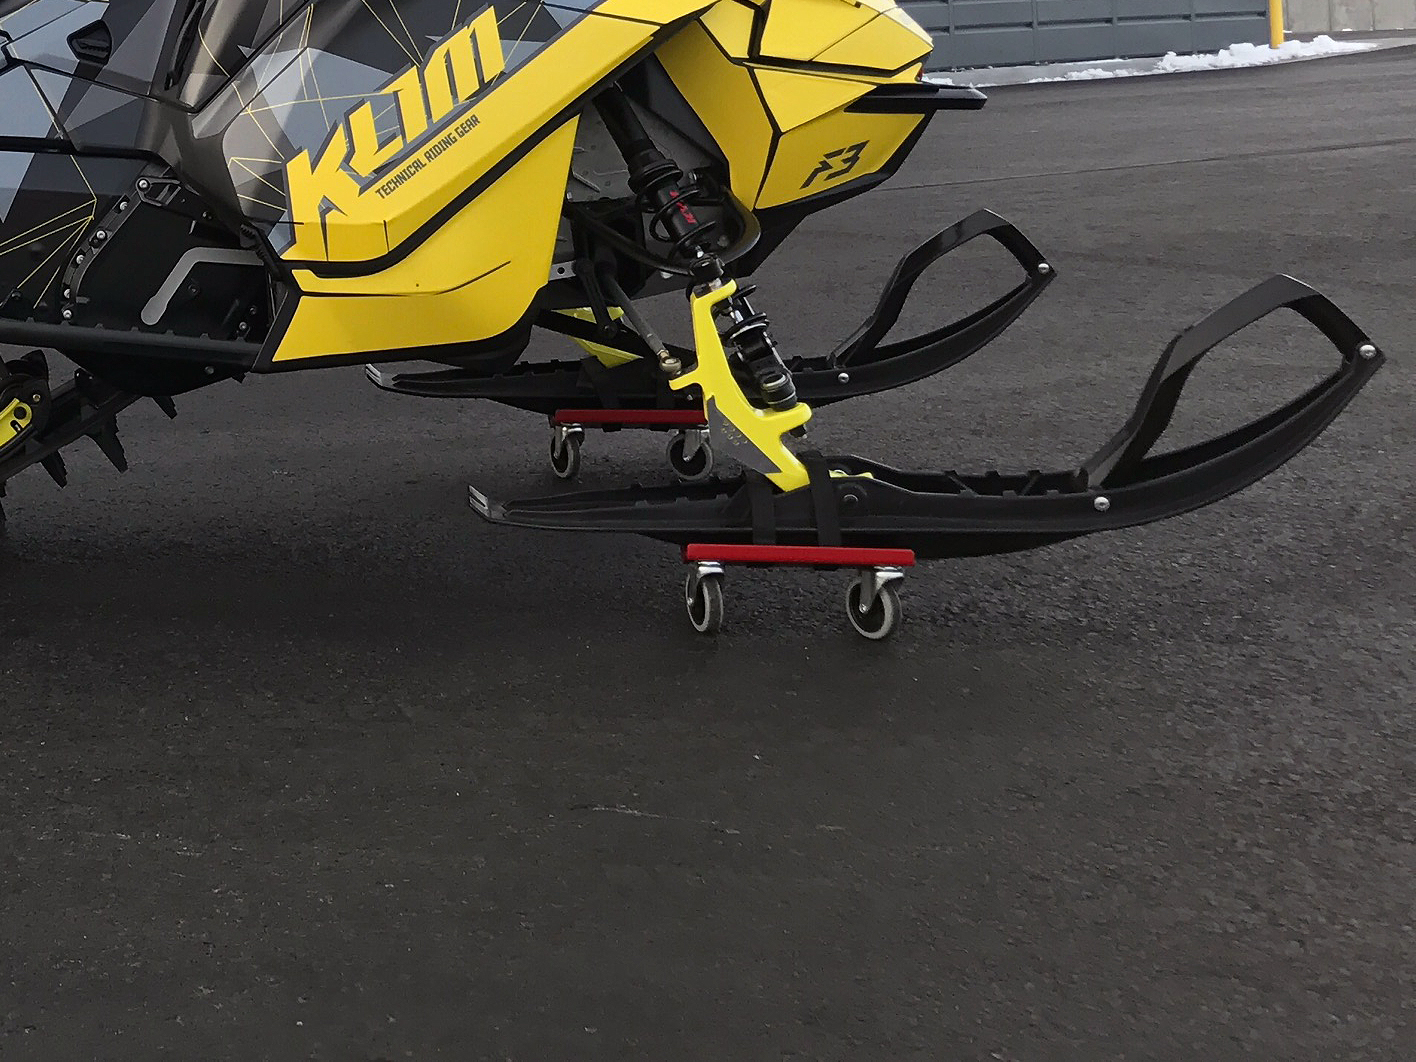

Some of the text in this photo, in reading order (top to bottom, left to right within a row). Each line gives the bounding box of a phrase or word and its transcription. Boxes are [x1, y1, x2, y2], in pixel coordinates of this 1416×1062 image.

[281, 4, 506, 261] KLIM
[374, 113, 481, 200] TECHNICAL RIDING GEAR
